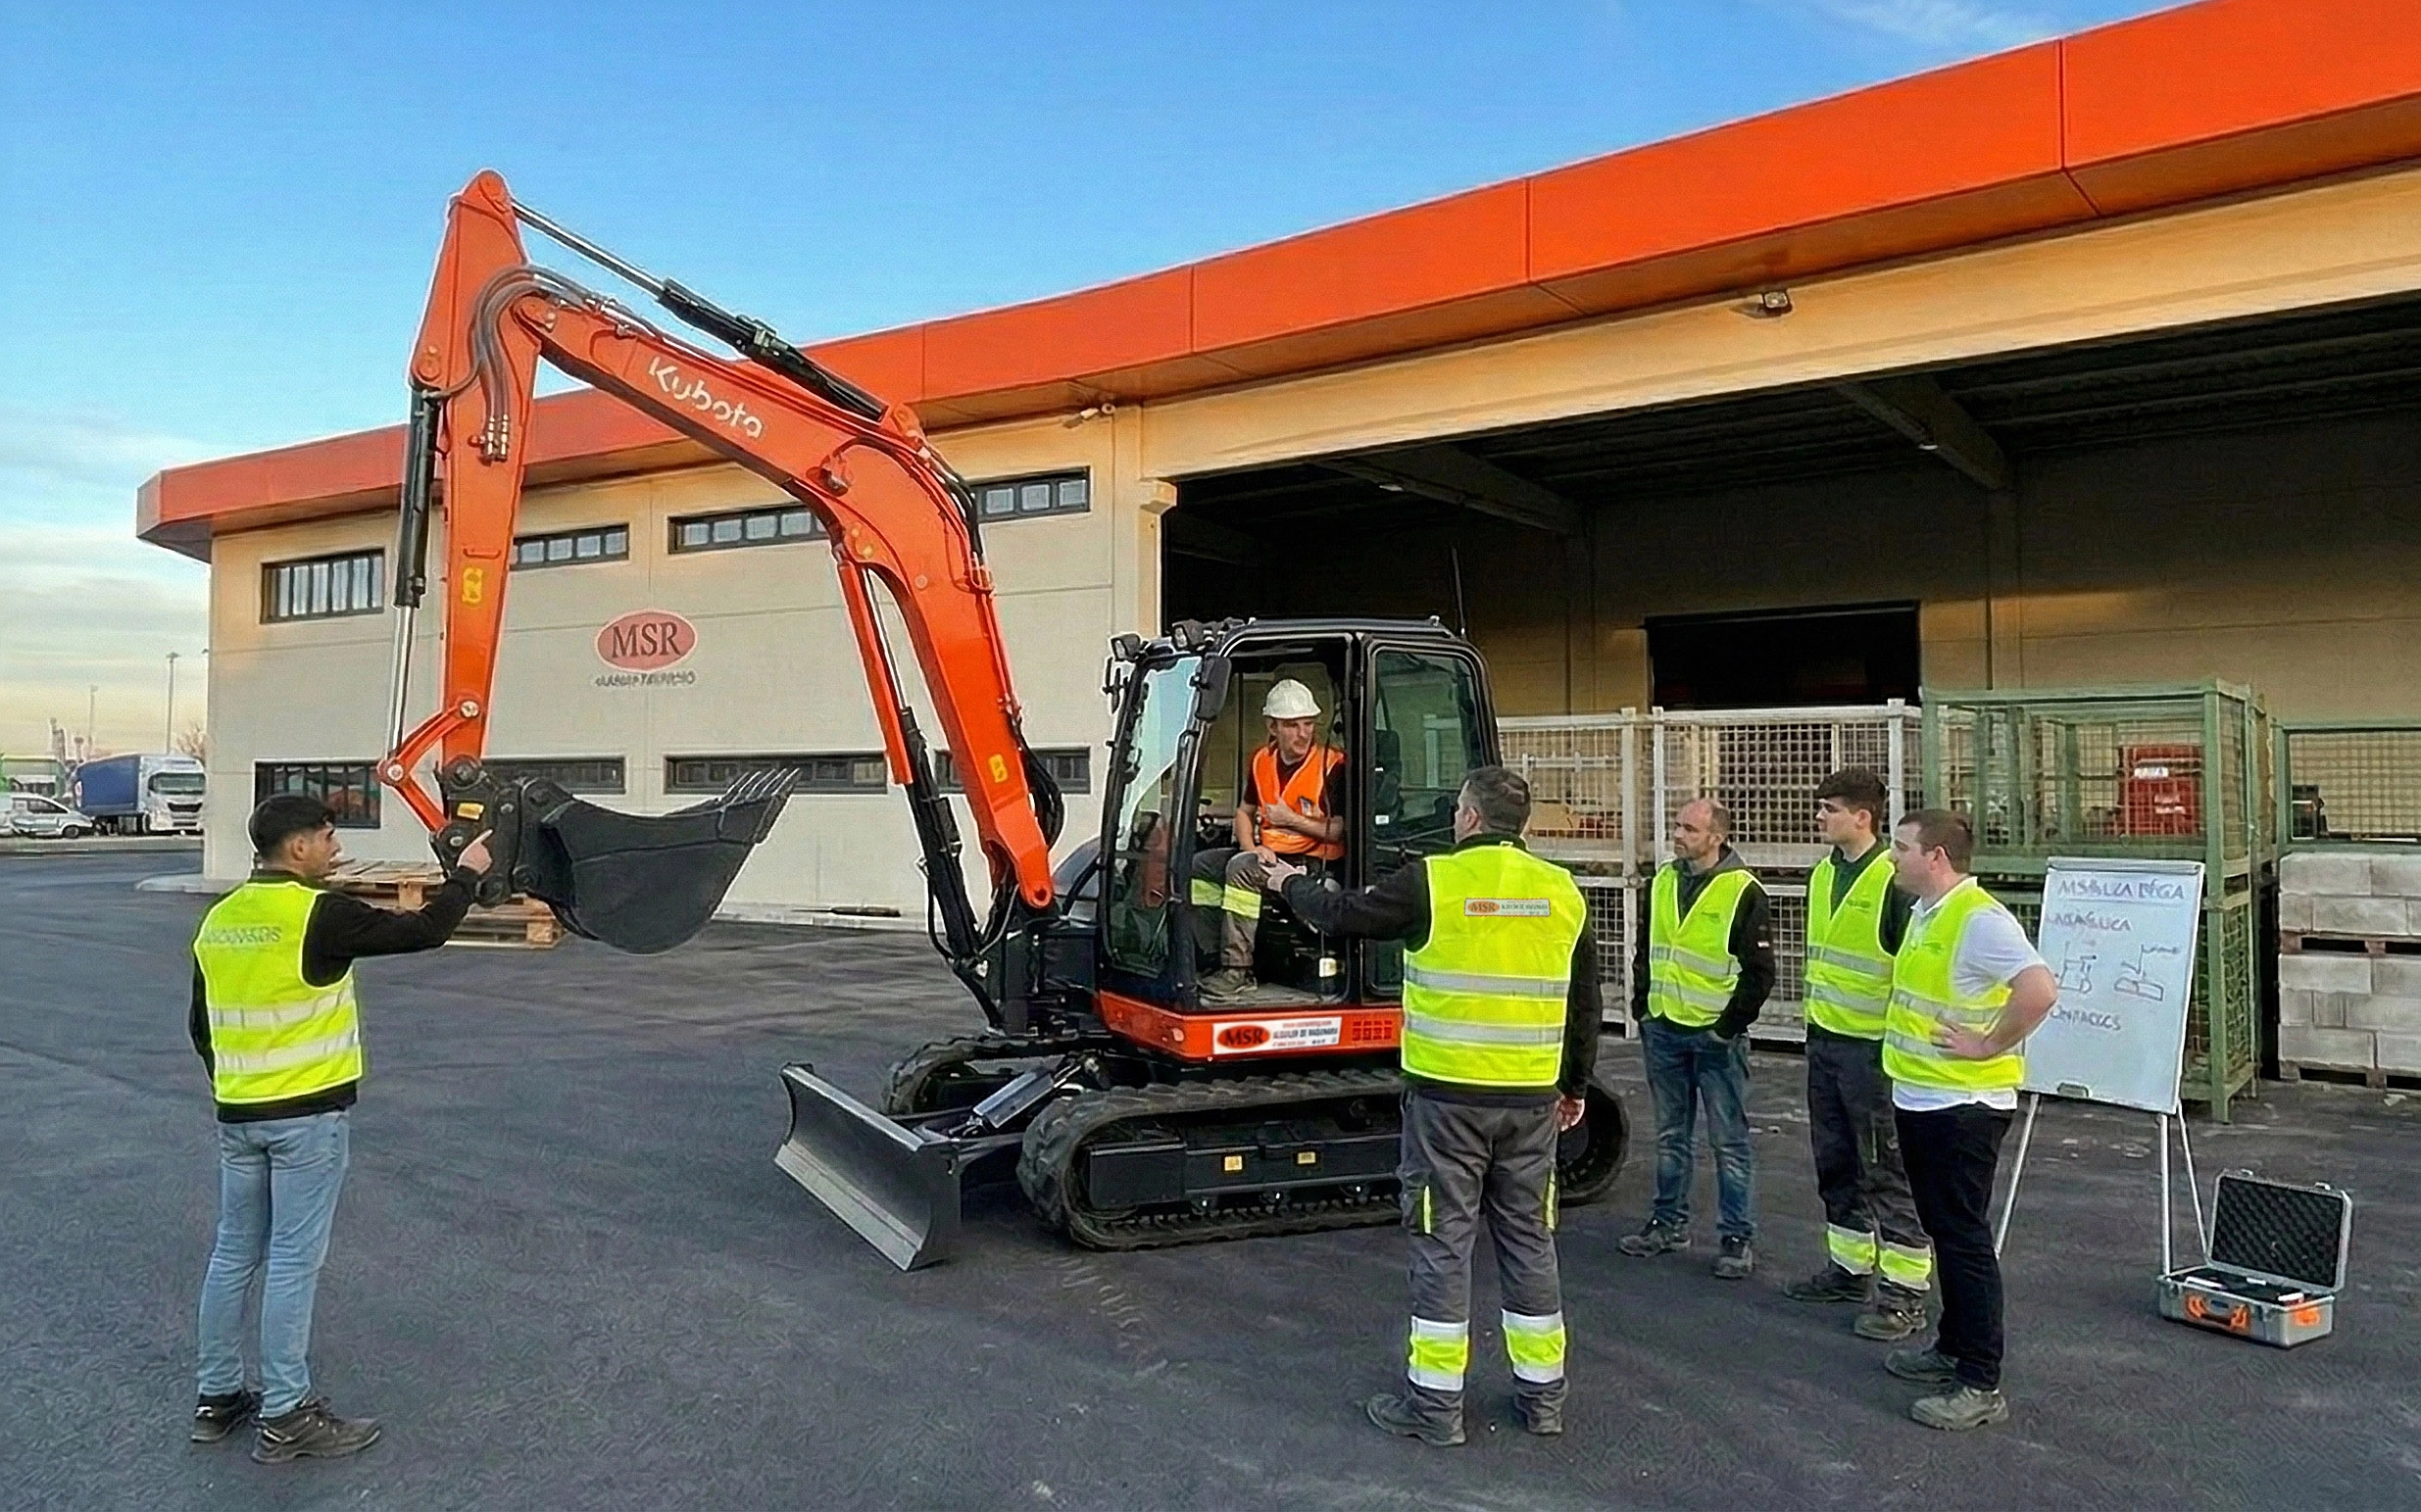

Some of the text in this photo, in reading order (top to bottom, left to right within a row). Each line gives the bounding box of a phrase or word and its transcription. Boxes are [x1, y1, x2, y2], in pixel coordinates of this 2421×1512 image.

[648, 356, 764, 439] Kubota
[612, 621, 681, 658] MSR
[1471, 902, 1496, 913] MSR
[1224, 1027, 1265, 1047] MSR
